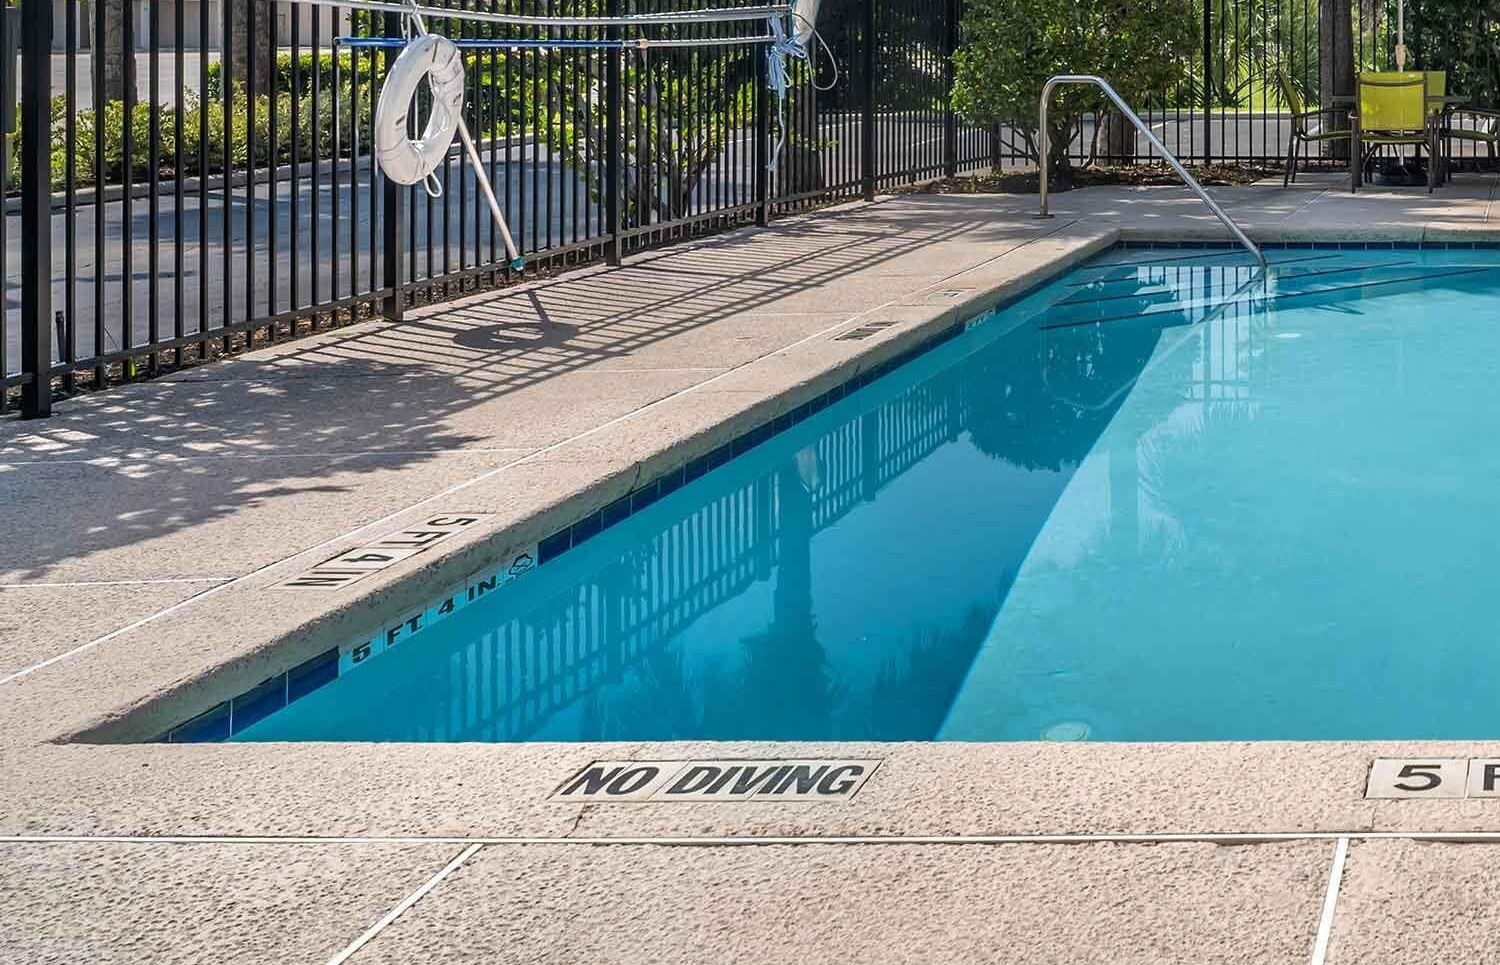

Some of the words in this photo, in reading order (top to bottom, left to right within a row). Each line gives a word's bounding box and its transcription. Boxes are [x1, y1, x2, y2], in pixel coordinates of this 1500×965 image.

[427, 517, 478, 526] 5
[380, 532, 451, 547] FT
[341, 554, 394, 562] 4
[284, 571, 366, 586] IN
[352, 641, 371, 664] 5
[438, 597, 456, 616] 4
[560, 766, 660, 796] NO
[665, 765, 865, 796] DIVING
[1393, 764, 1442, 791] 5
